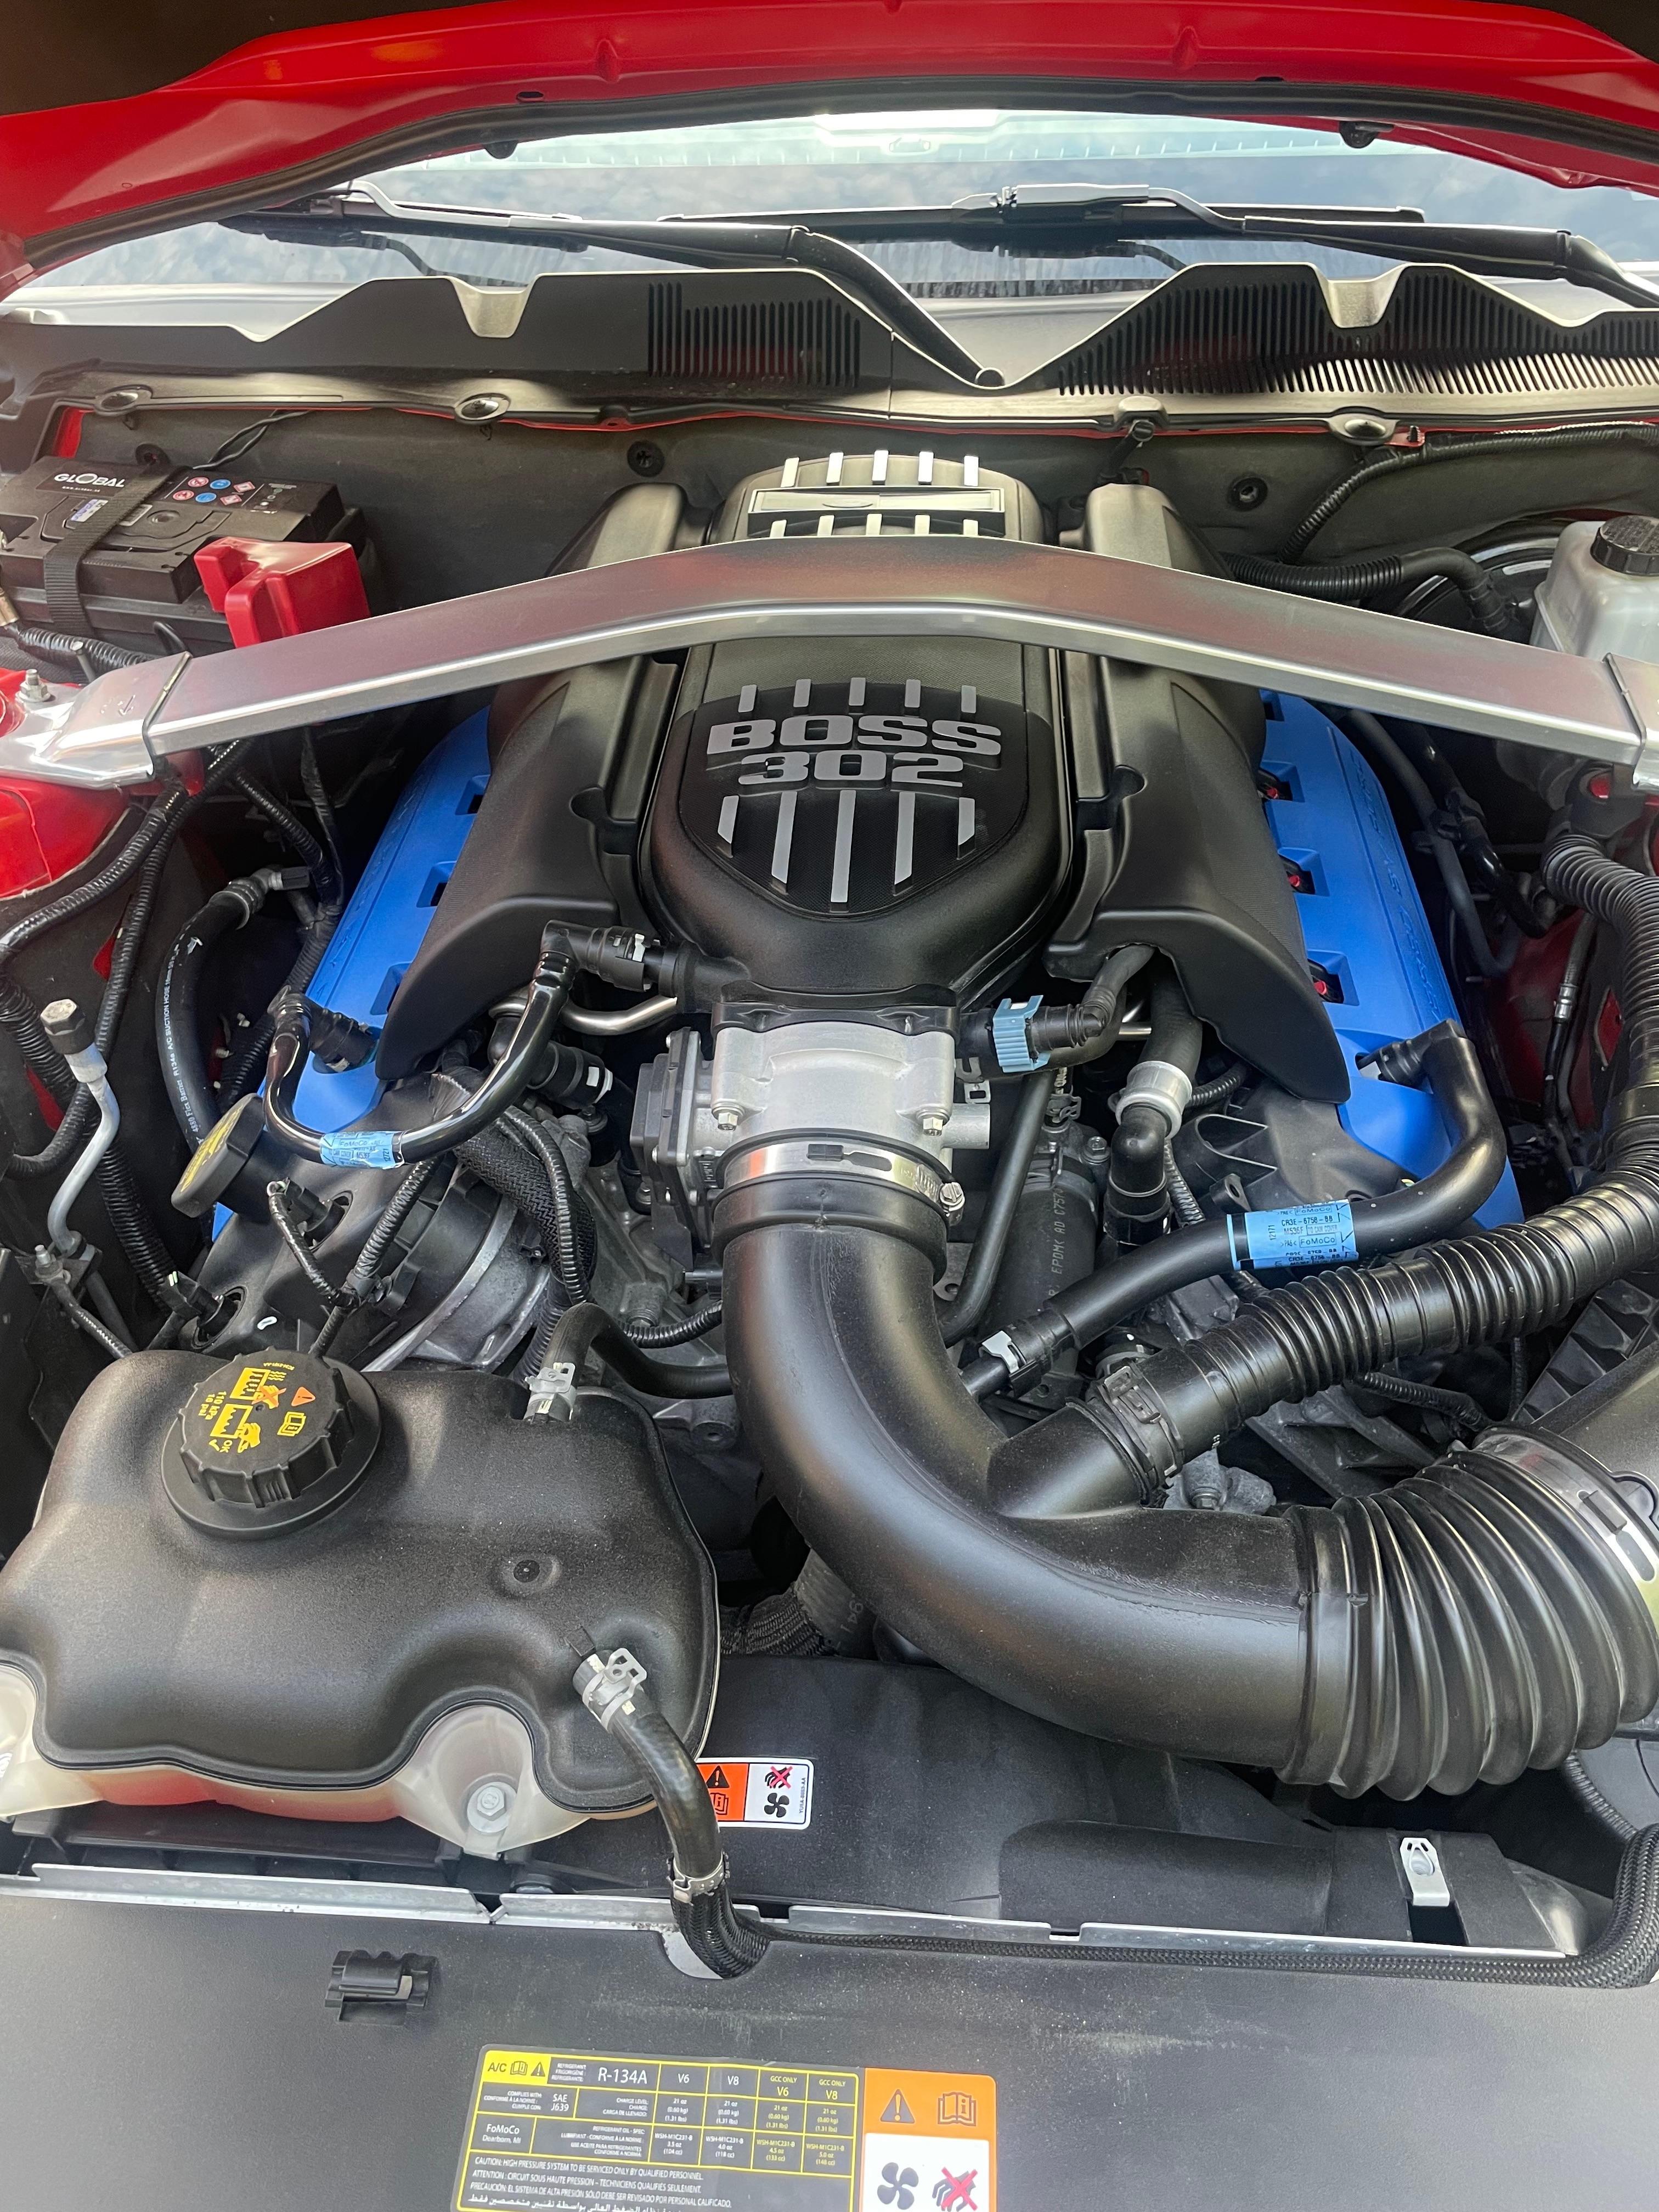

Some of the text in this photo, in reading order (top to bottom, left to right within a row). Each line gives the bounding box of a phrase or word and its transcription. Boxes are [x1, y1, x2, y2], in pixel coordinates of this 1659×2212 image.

[54, 473, 126, 487] GLOBAL
[707, 715, 1001, 756] BOSS
[738, 749, 963, 788] 302
[170, 1053, 179, 1076] R134a
[184, 1102, 193, 1117] Flex
[1054, 1221, 1065, 1234] AD
[1268, 1225, 1277, 1240] 12171
[1284, 1226, 1304, 1235] M536F
[1301, 1237, 1335, 1245] FoMoCo
[205, 1394, 215, 1403] 10
[213, 1391, 227, 1404] 110
[219, 1440, 233, 1453] OK
[488, 2062, 506, 2072] A/C
[598, 2067, 647, 2084] R-134A
[678, 2074, 690, 2083] V6
[727, 2075, 739, 2085] V8
[777, 2086, 789, 2096] V6
[826, 2090, 838, 2100] V8
[553, 2094, 567, 2102] SAE
[551, 2103, 569, 2112] J639
[486, 2123, 520, 2134] FoMoCo
[482, 2134, 511, 2143] Dearborn,
[475, 2157, 502, 2166] CAUTION:
[503, 2159, 517, 2167] HIGH
[518, 2160, 546, 2169] PRESSURE
[547, 2162, 569, 2171] SYSTEM
[586, 2165, 613, 2174] SERVICED
[614, 2166, 629, 2175] ONLY
[629, 2168, 638, 2176] BY
[639, 2168, 668, 2178] QUALIFIED
[669, 2170, 703, 2180] PERSONNEL.
[472, 2170, 504, 2179] ATTENTION
[507, 2172, 530, 2181] CIRCUIT
[531, 2174, 546, 2182] SOUS
[546, 2175, 566, 2184] HAUTE
[567, 2176, 594, 2186] PRESSION
[600, 2179, 636, 2189] TECHNICIENS
[515, 2185, 539, 2194] SISTEMA
[601, 2191, 616, 2200] DEBE
[617, 2192, 627, 2200] SER
[627, 2193, 654, 2203] REVISADO
[655, 2195, 667, 2204] POR
[668, 2196, 696, 2206] PERSONAL
